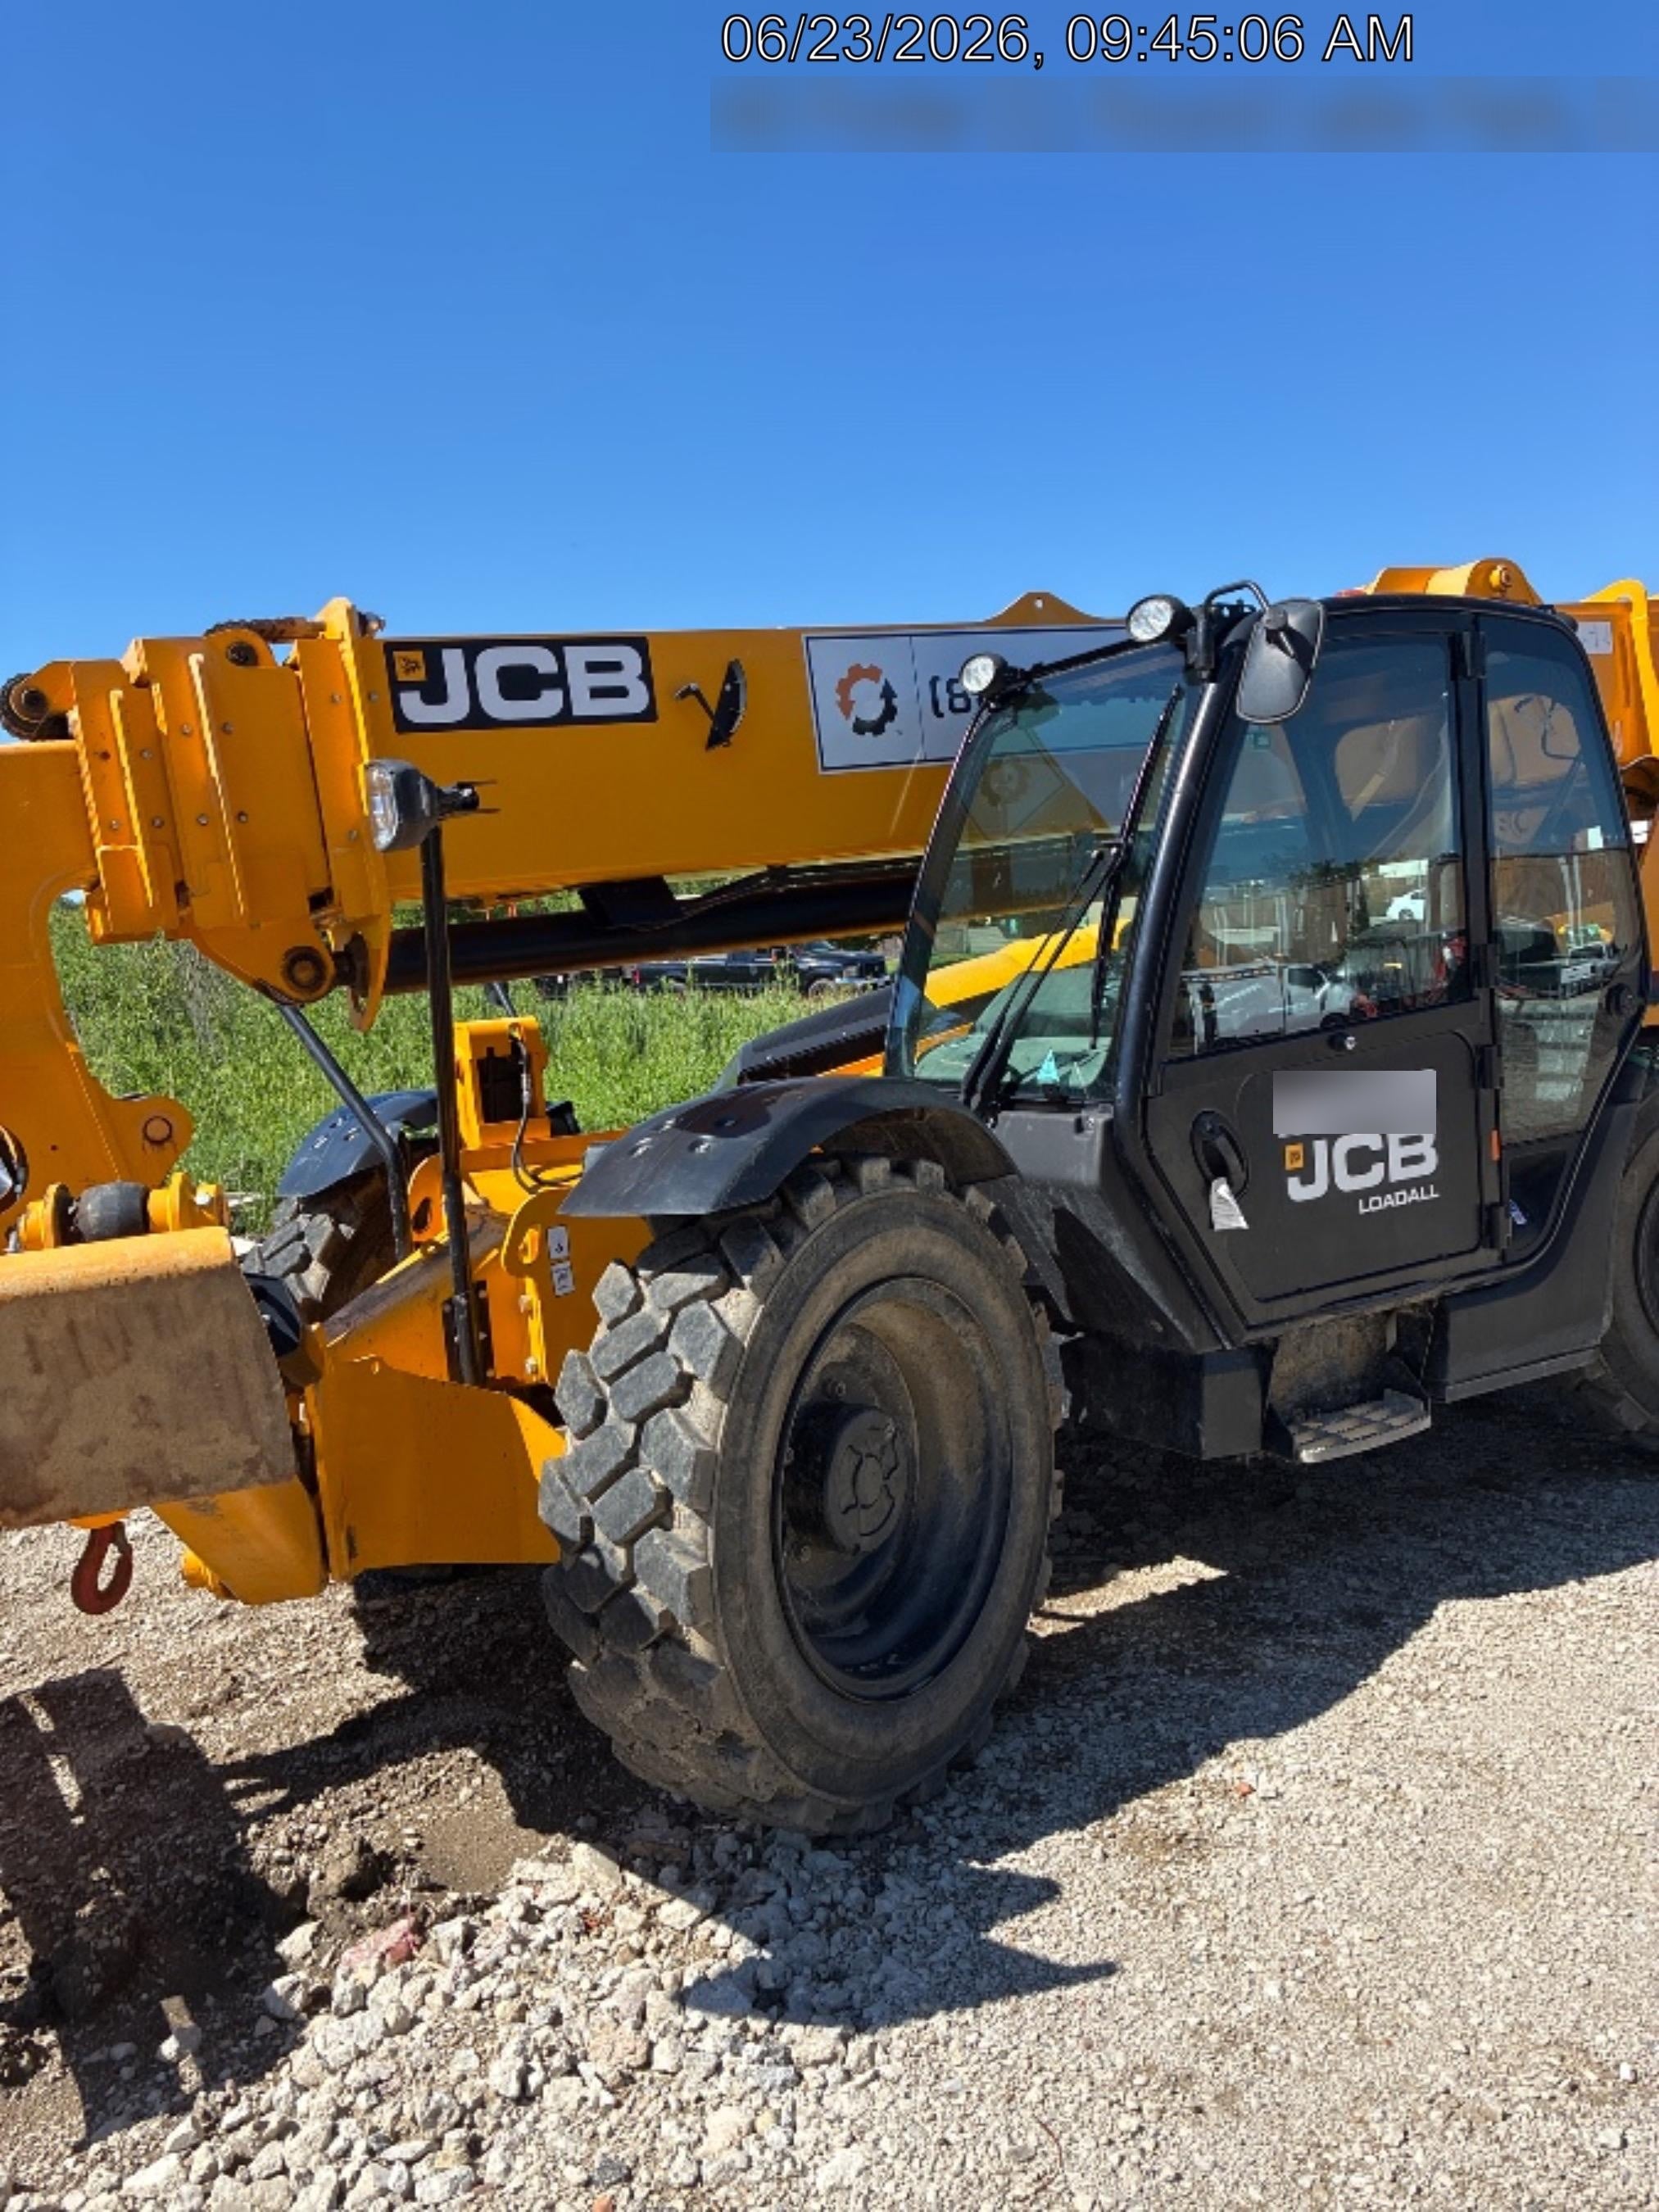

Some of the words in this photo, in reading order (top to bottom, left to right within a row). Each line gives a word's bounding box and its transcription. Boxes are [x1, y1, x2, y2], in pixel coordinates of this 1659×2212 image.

[399, 645, 650, 724] JCB
[1287, 1133, 1439, 1203] JCB
[1358, 1185, 1440, 1215] LOADALL
